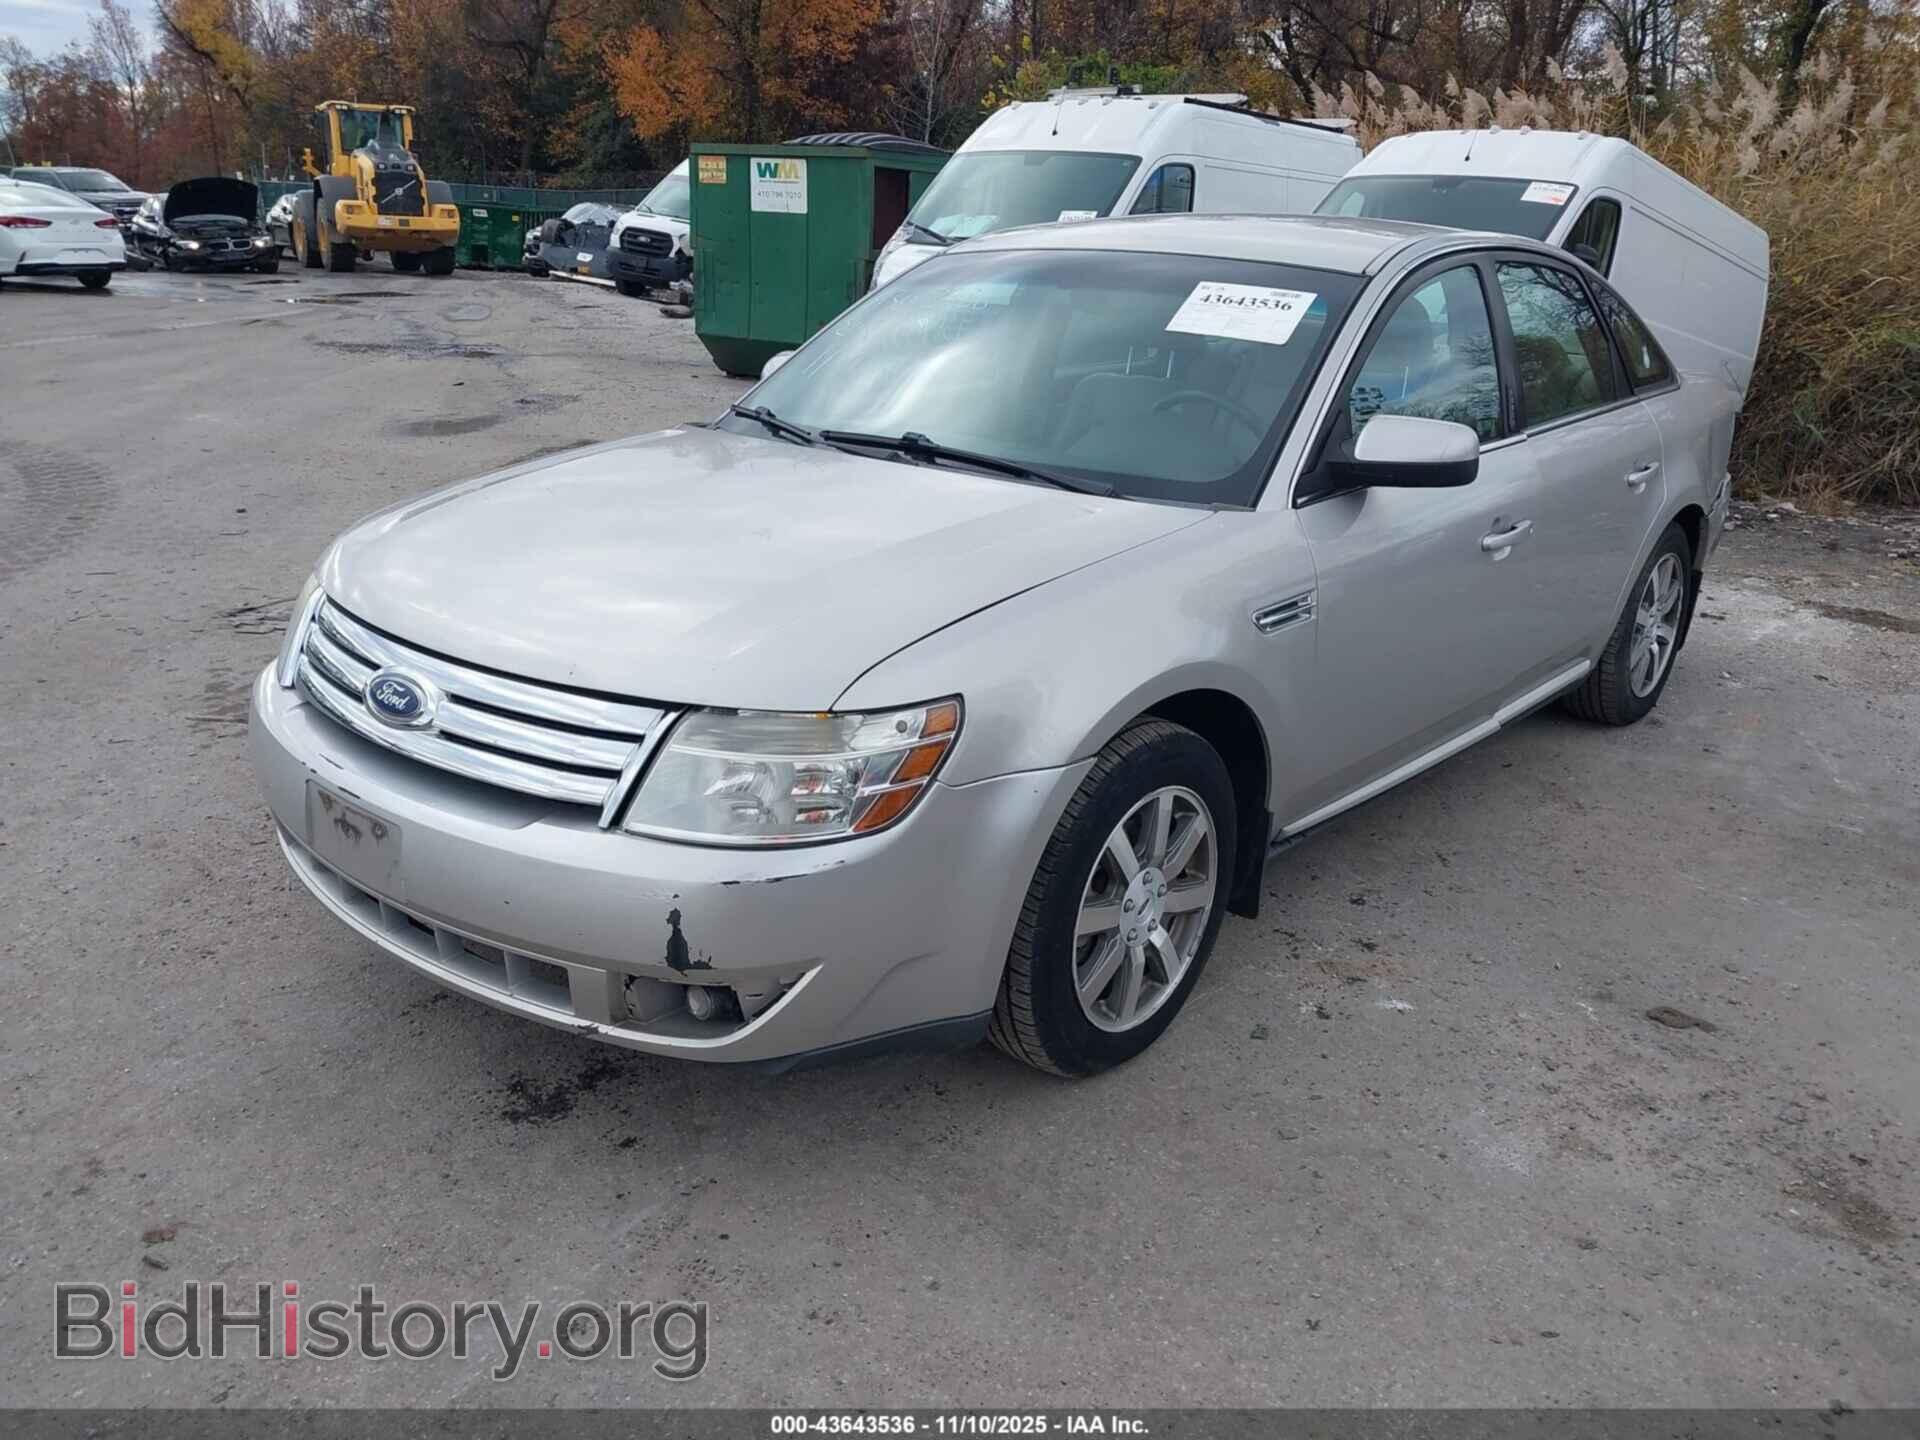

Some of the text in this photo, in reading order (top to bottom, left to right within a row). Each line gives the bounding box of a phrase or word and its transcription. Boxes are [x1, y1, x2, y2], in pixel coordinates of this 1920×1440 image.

[756, 162, 800, 179] WM
[1200, 293, 1292, 311] 43643536
[376, 681, 411, 711] Ford
